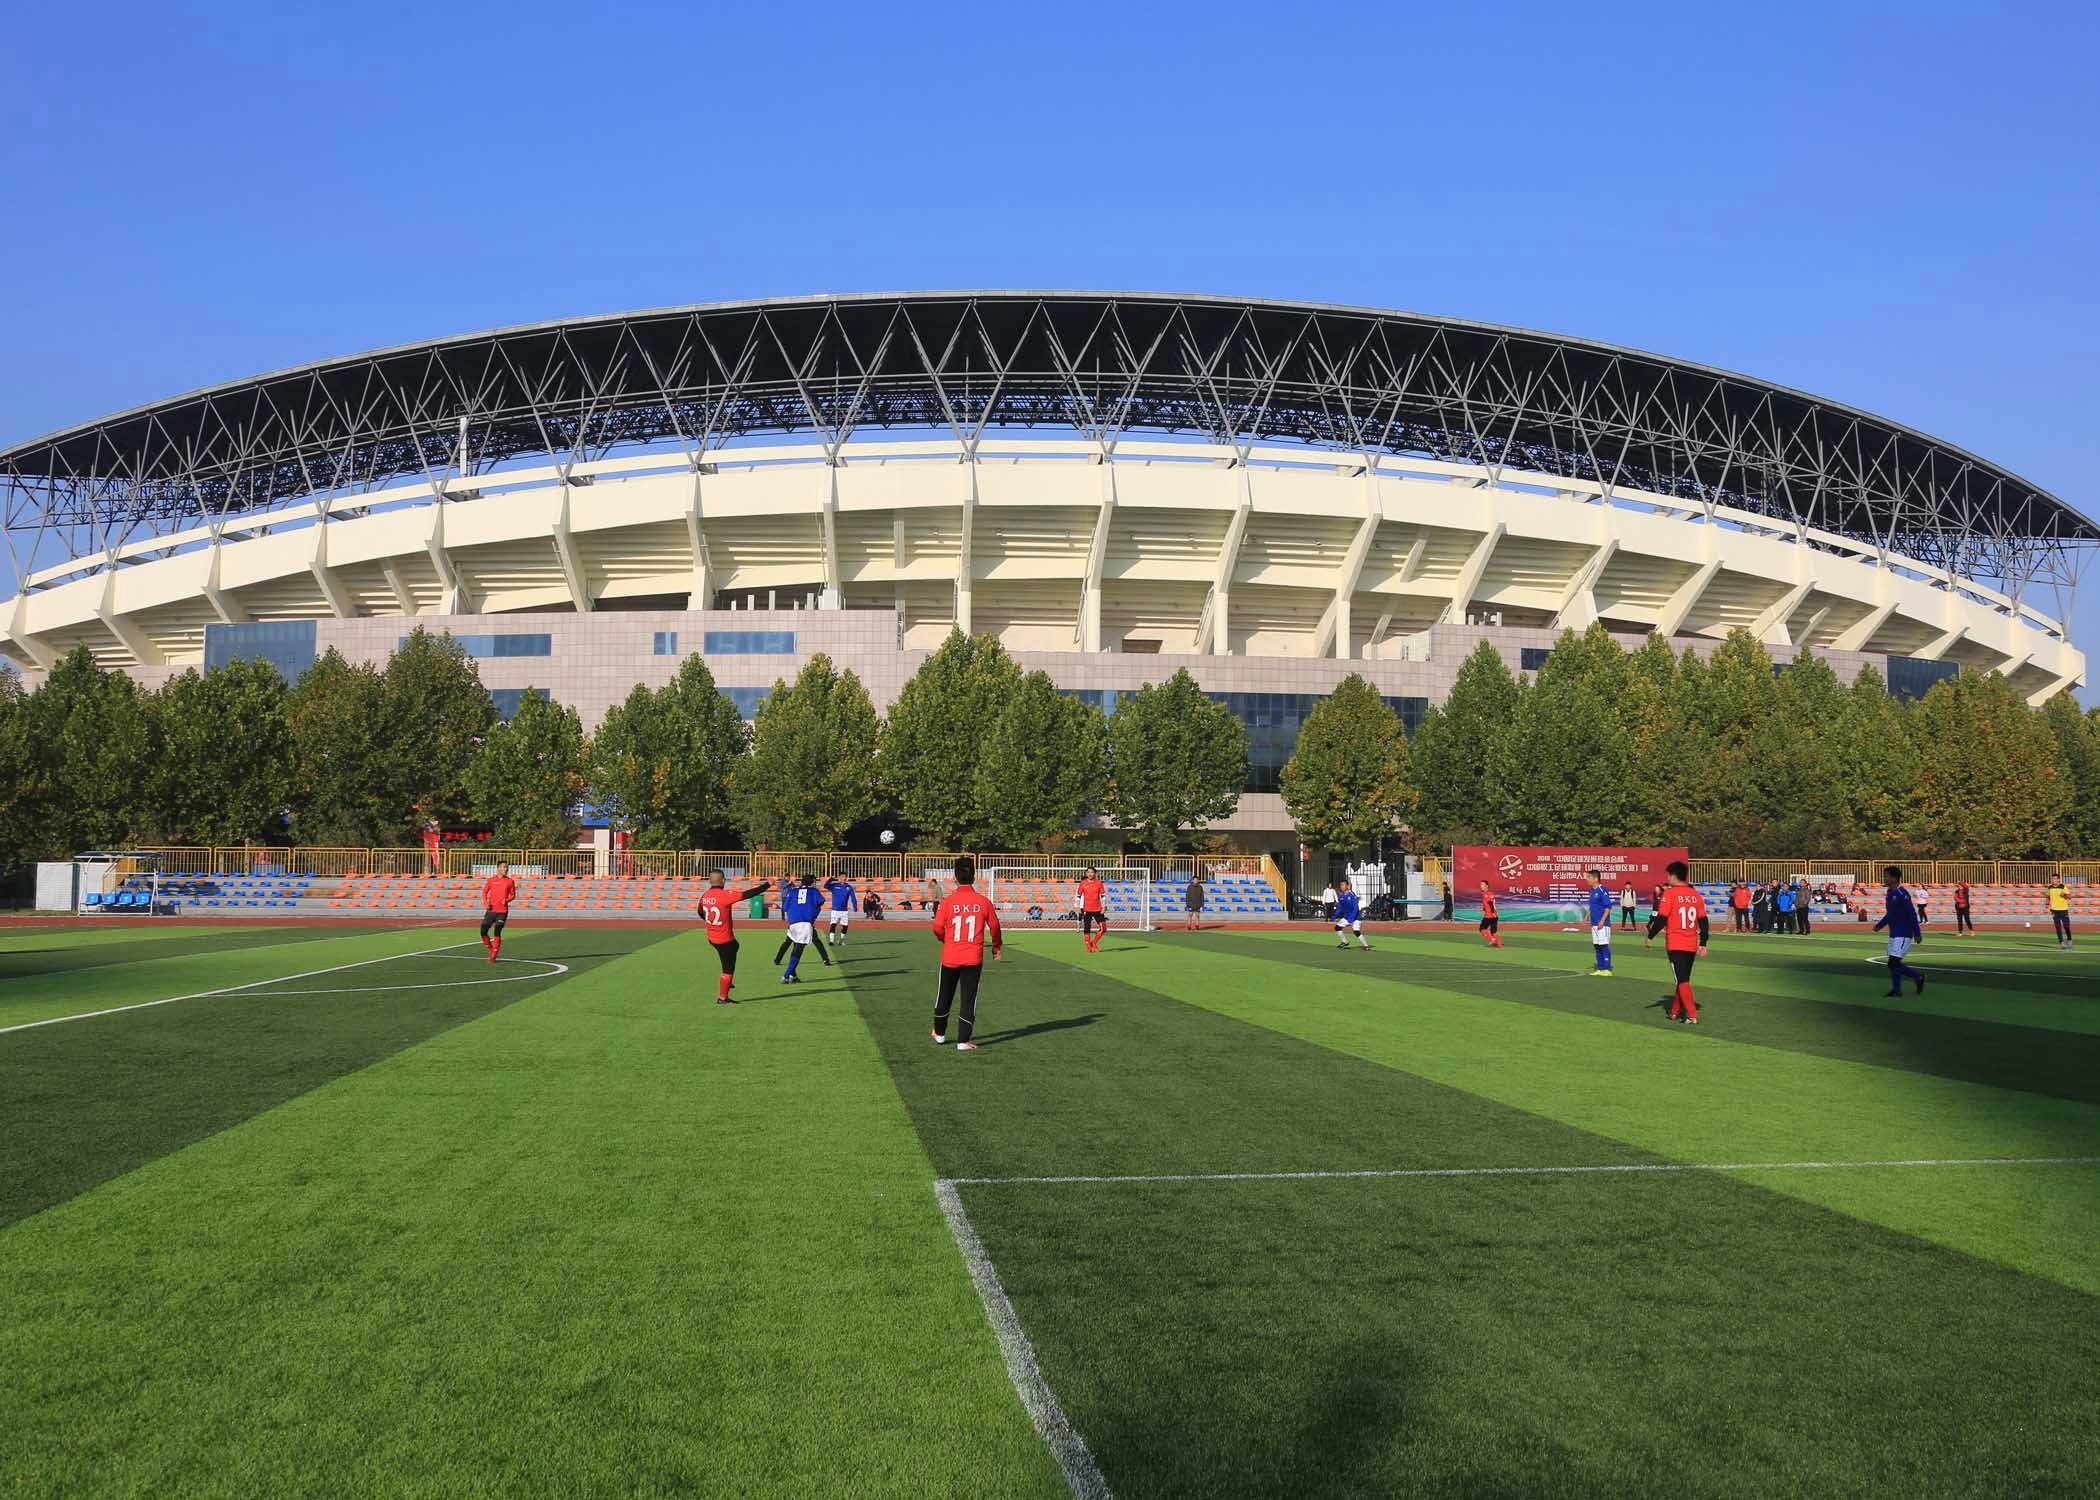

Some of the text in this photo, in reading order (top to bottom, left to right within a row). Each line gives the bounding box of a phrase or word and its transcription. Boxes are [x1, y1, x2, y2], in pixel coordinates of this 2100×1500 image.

[1677, 895, 1697, 903] BKD
[953, 904, 981, 913] BKD
[1678, 906, 1697, 930] 19
[952, 915, 976, 943] 11
